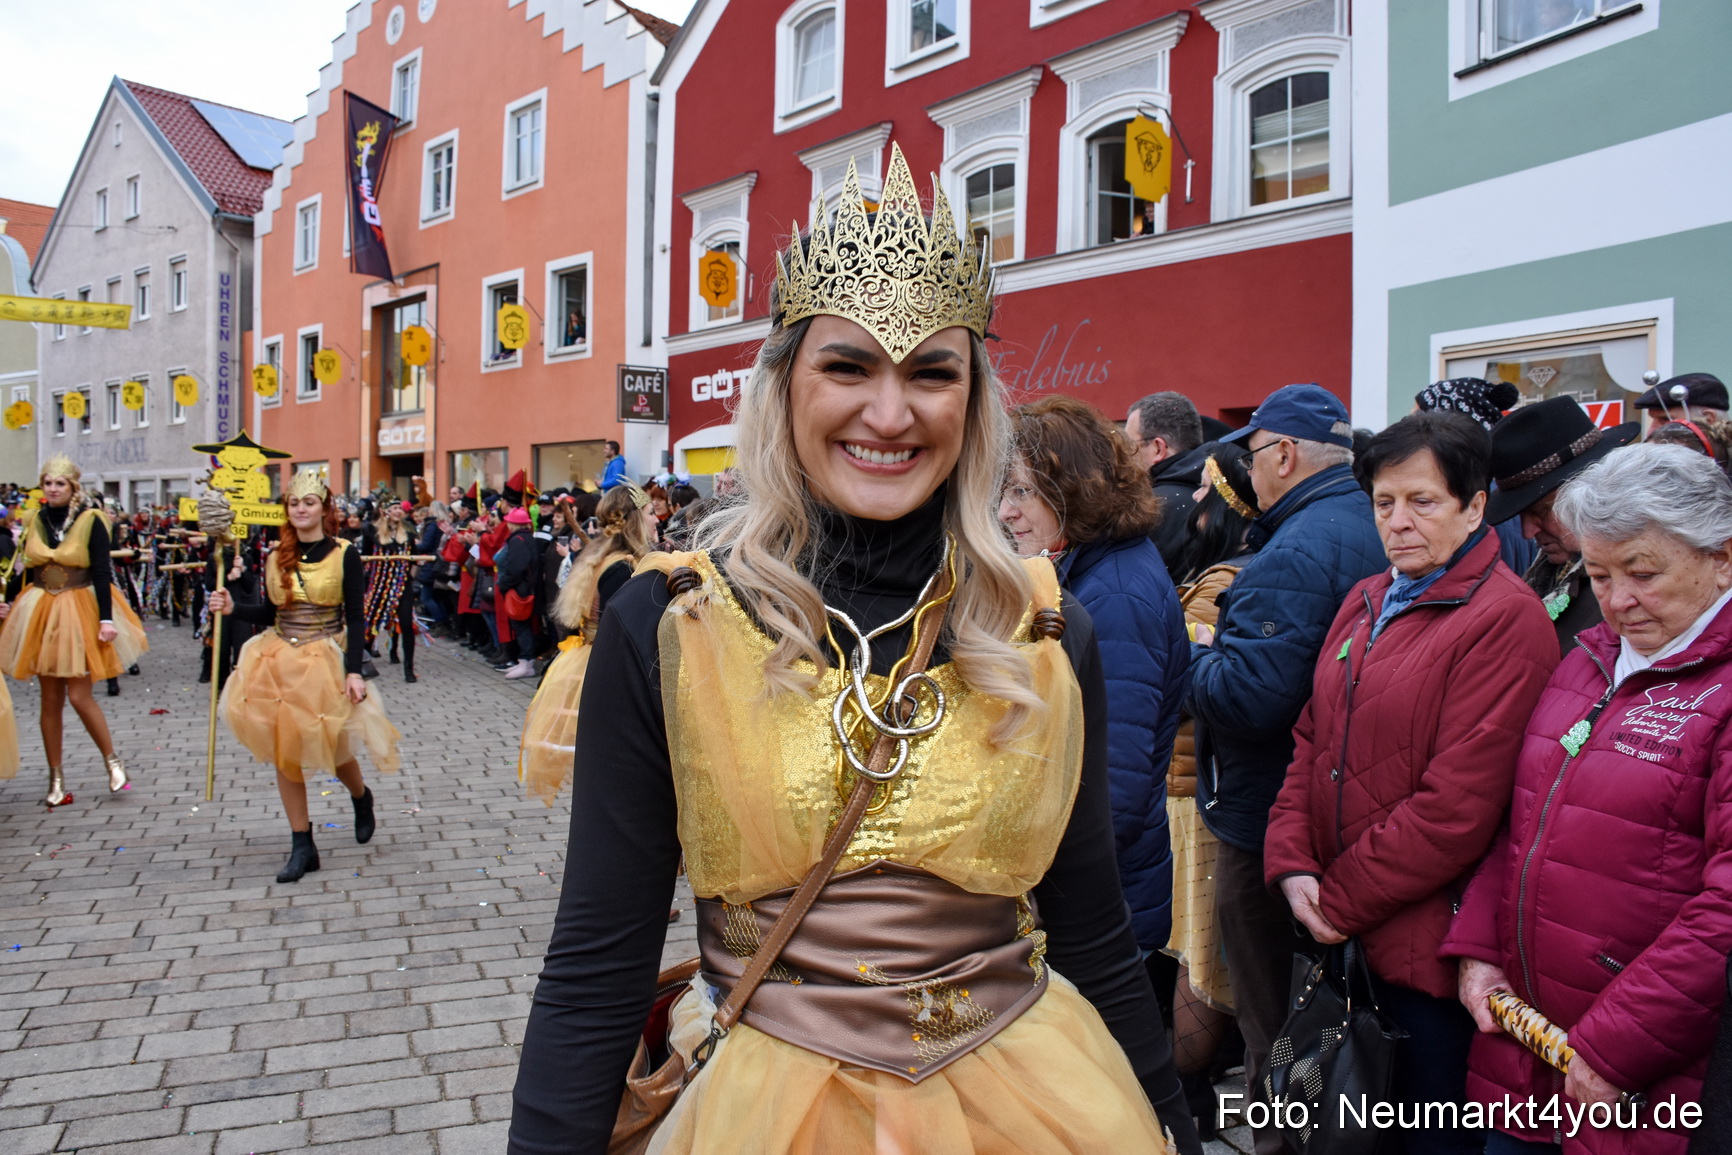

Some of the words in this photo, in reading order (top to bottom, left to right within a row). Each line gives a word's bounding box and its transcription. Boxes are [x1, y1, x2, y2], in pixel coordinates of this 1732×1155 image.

[219, 273, 230, 342] UHREN
[991, 318, 1112, 391] Erlebnis
[624, 373, 661, 393] CAFÉ
[691, 368, 755, 402] GÖT
[378, 425, 425, 446] GÖTZ
[1625, 682, 1722, 717] Sail
[1609, 731, 1642, 746] LIMITED
[1644, 739, 1683, 757] EDITION
